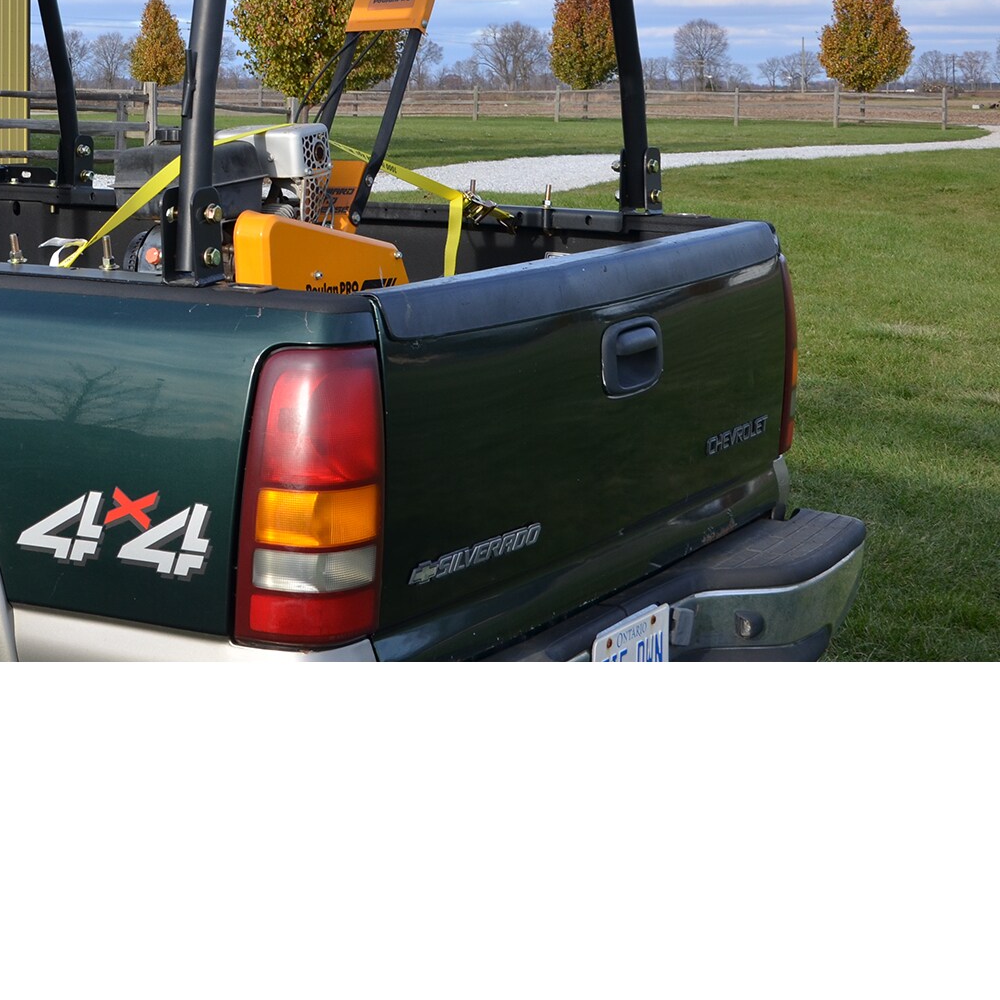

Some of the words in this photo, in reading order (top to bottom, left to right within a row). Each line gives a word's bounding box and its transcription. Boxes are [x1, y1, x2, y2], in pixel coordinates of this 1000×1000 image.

[706, 414, 768, 455] CHEVROLET
[436, 522, 541, 579] SILVERADO
[616, 621, 648, 648] ONTARIO
